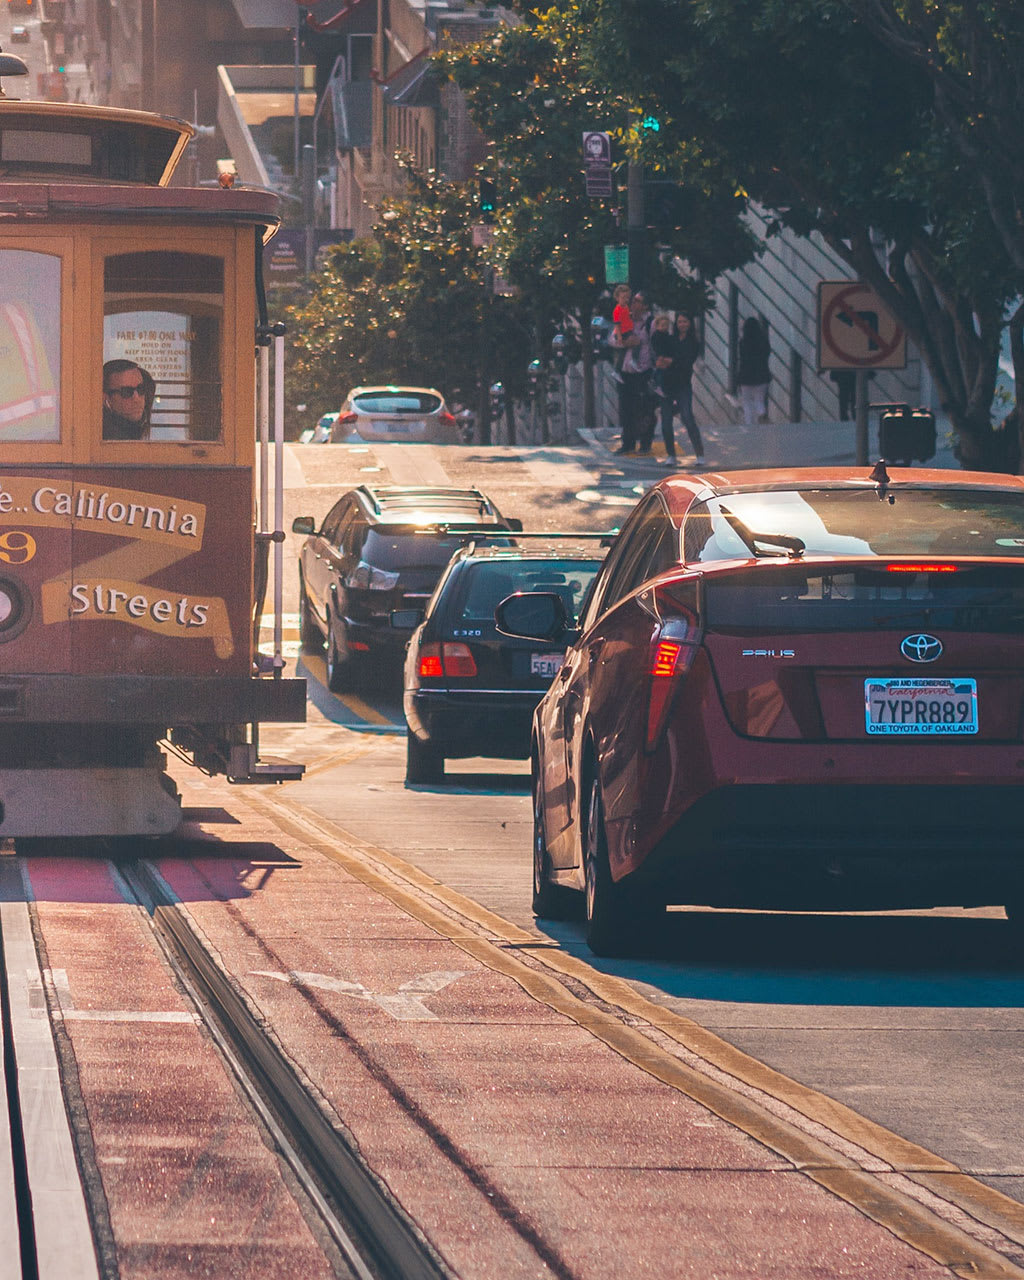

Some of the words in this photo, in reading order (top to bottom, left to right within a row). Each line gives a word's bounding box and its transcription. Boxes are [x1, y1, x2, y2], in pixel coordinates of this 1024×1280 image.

[116, 331, 136, 340] FARE
[159, 331, 176, 340] ONE
[33, 486, 198, 538] California
[71, 584, 210, 628] Streets
[742, 649, 795, 658] PRIUS
[873, 700, 969, 723] 7YPR889
[869, 724, 887, 733] ONE
[888, 724, 919, 733] TOYOTA
[921, 724, 933, 733] OF
[935, 724, 976, 733] OAKLAND
